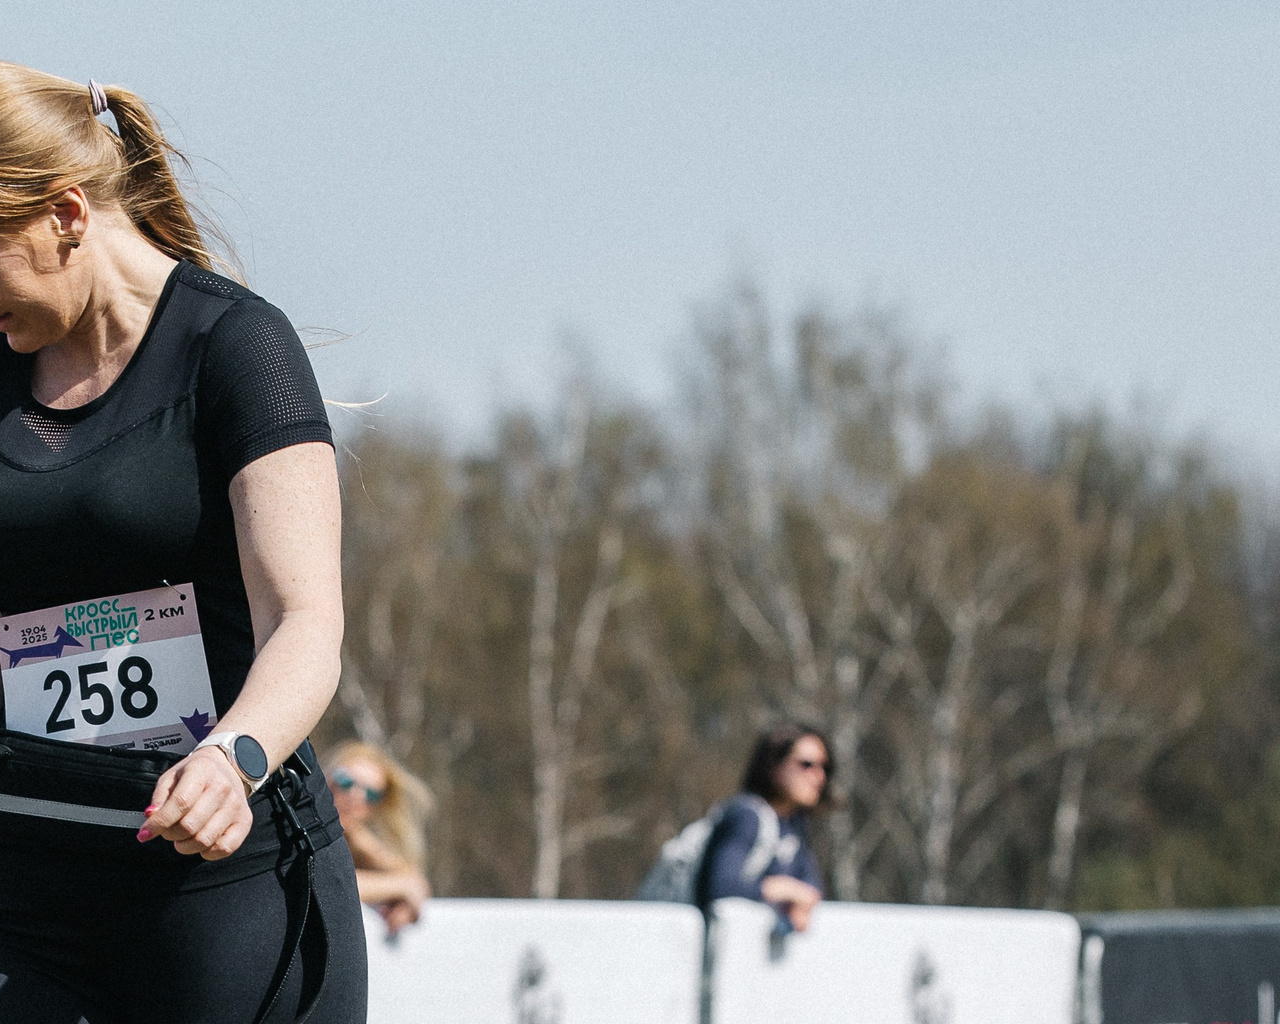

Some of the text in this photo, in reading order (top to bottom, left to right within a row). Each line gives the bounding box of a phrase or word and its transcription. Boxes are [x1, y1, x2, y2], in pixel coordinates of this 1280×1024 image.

[65, 598, 120, 622] КРОСС
[144, 606, 184, 621] 2 КМ
[21, 625, 46, 637] 19.04
[66, 606, 139, 637] БЫСТРЫЙ
[22, 633, 48, 645] 2025
[43, 656, 158, 734] 258
